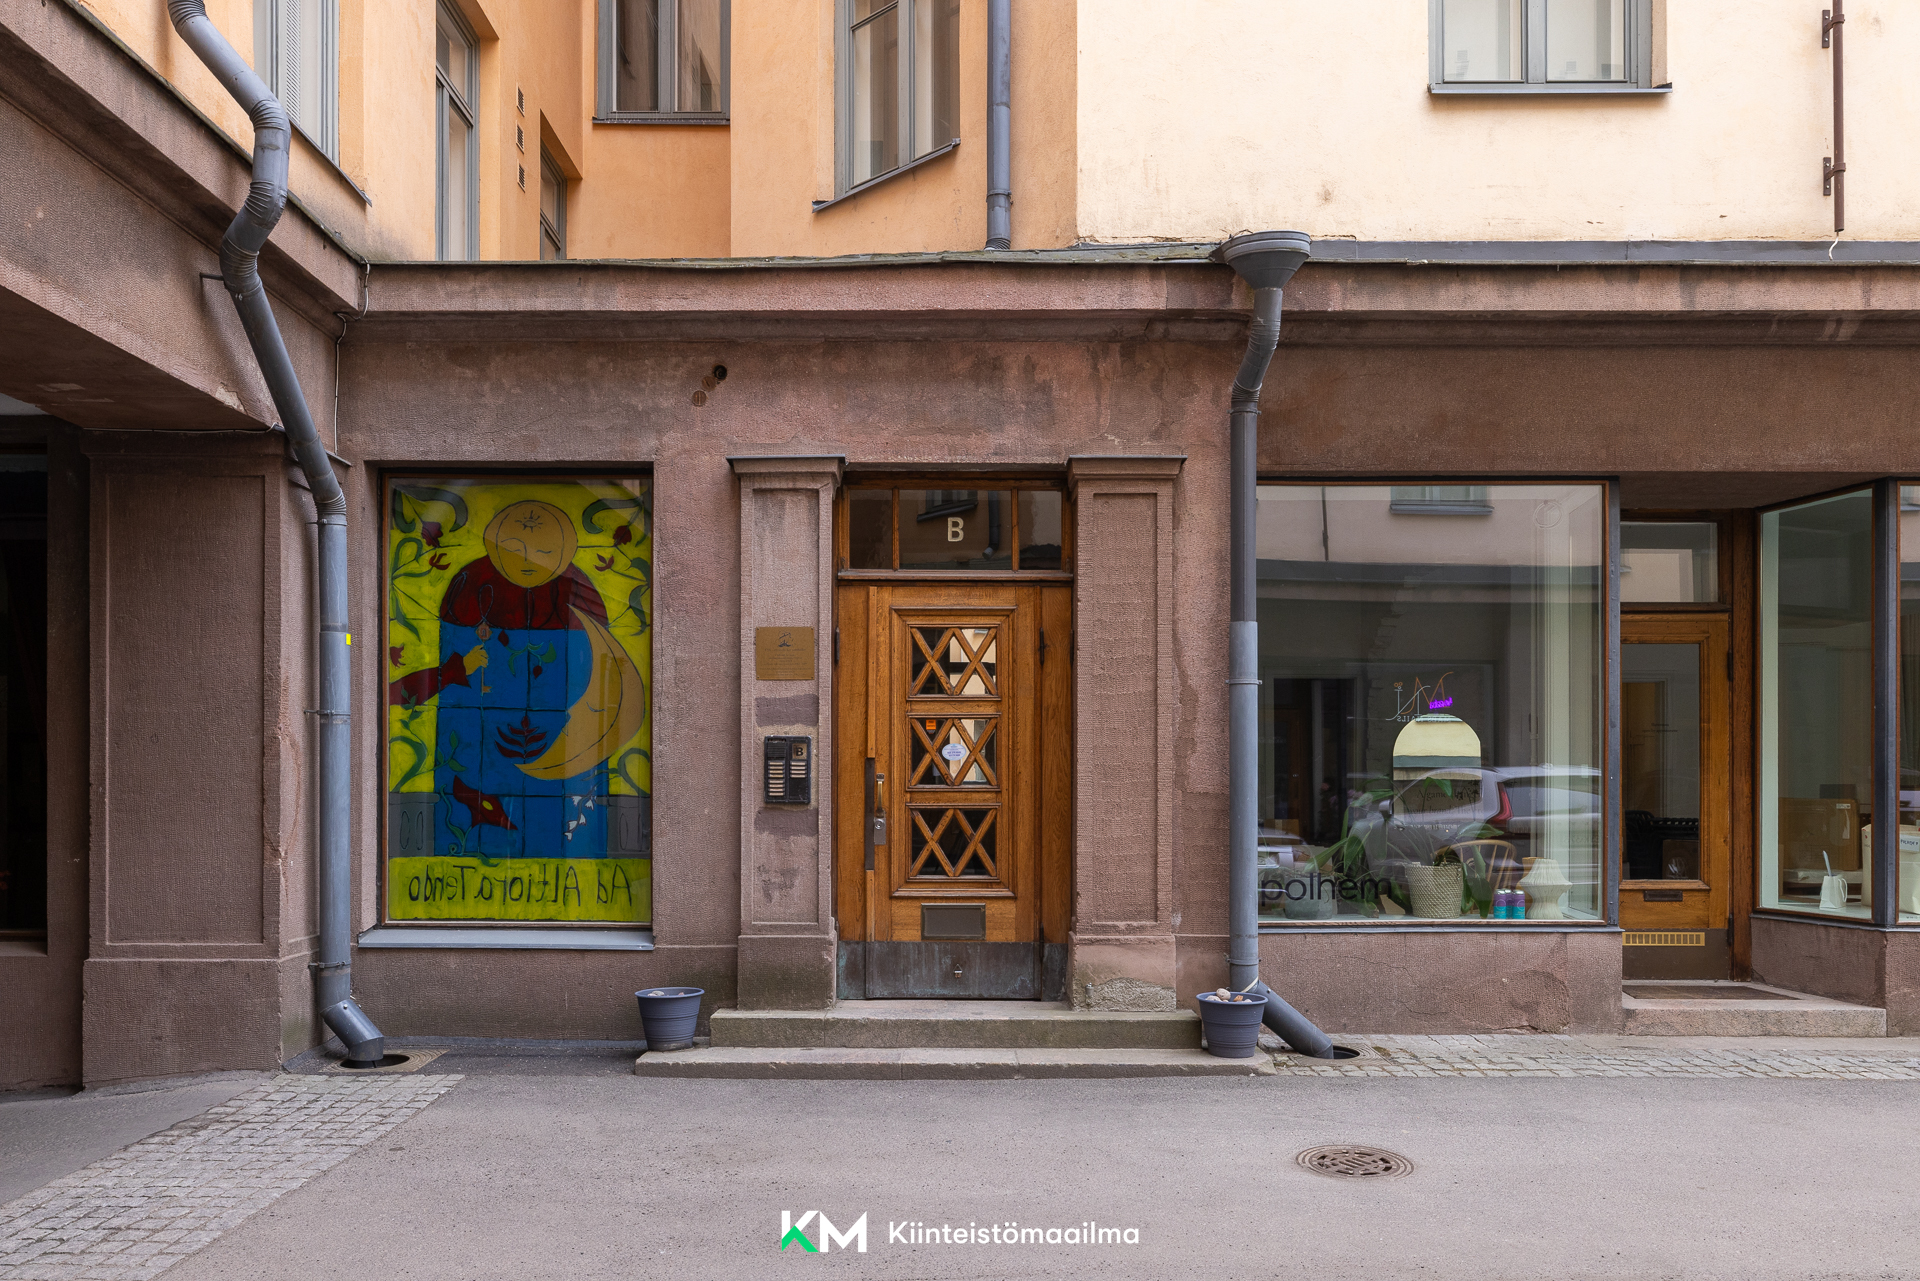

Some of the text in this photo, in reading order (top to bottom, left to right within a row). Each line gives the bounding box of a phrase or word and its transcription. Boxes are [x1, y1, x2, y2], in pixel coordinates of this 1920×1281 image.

[947, 516, 964, 542] B
[795, 746, 804, 757] B
[1261, 873, 1393, 907] polhem
